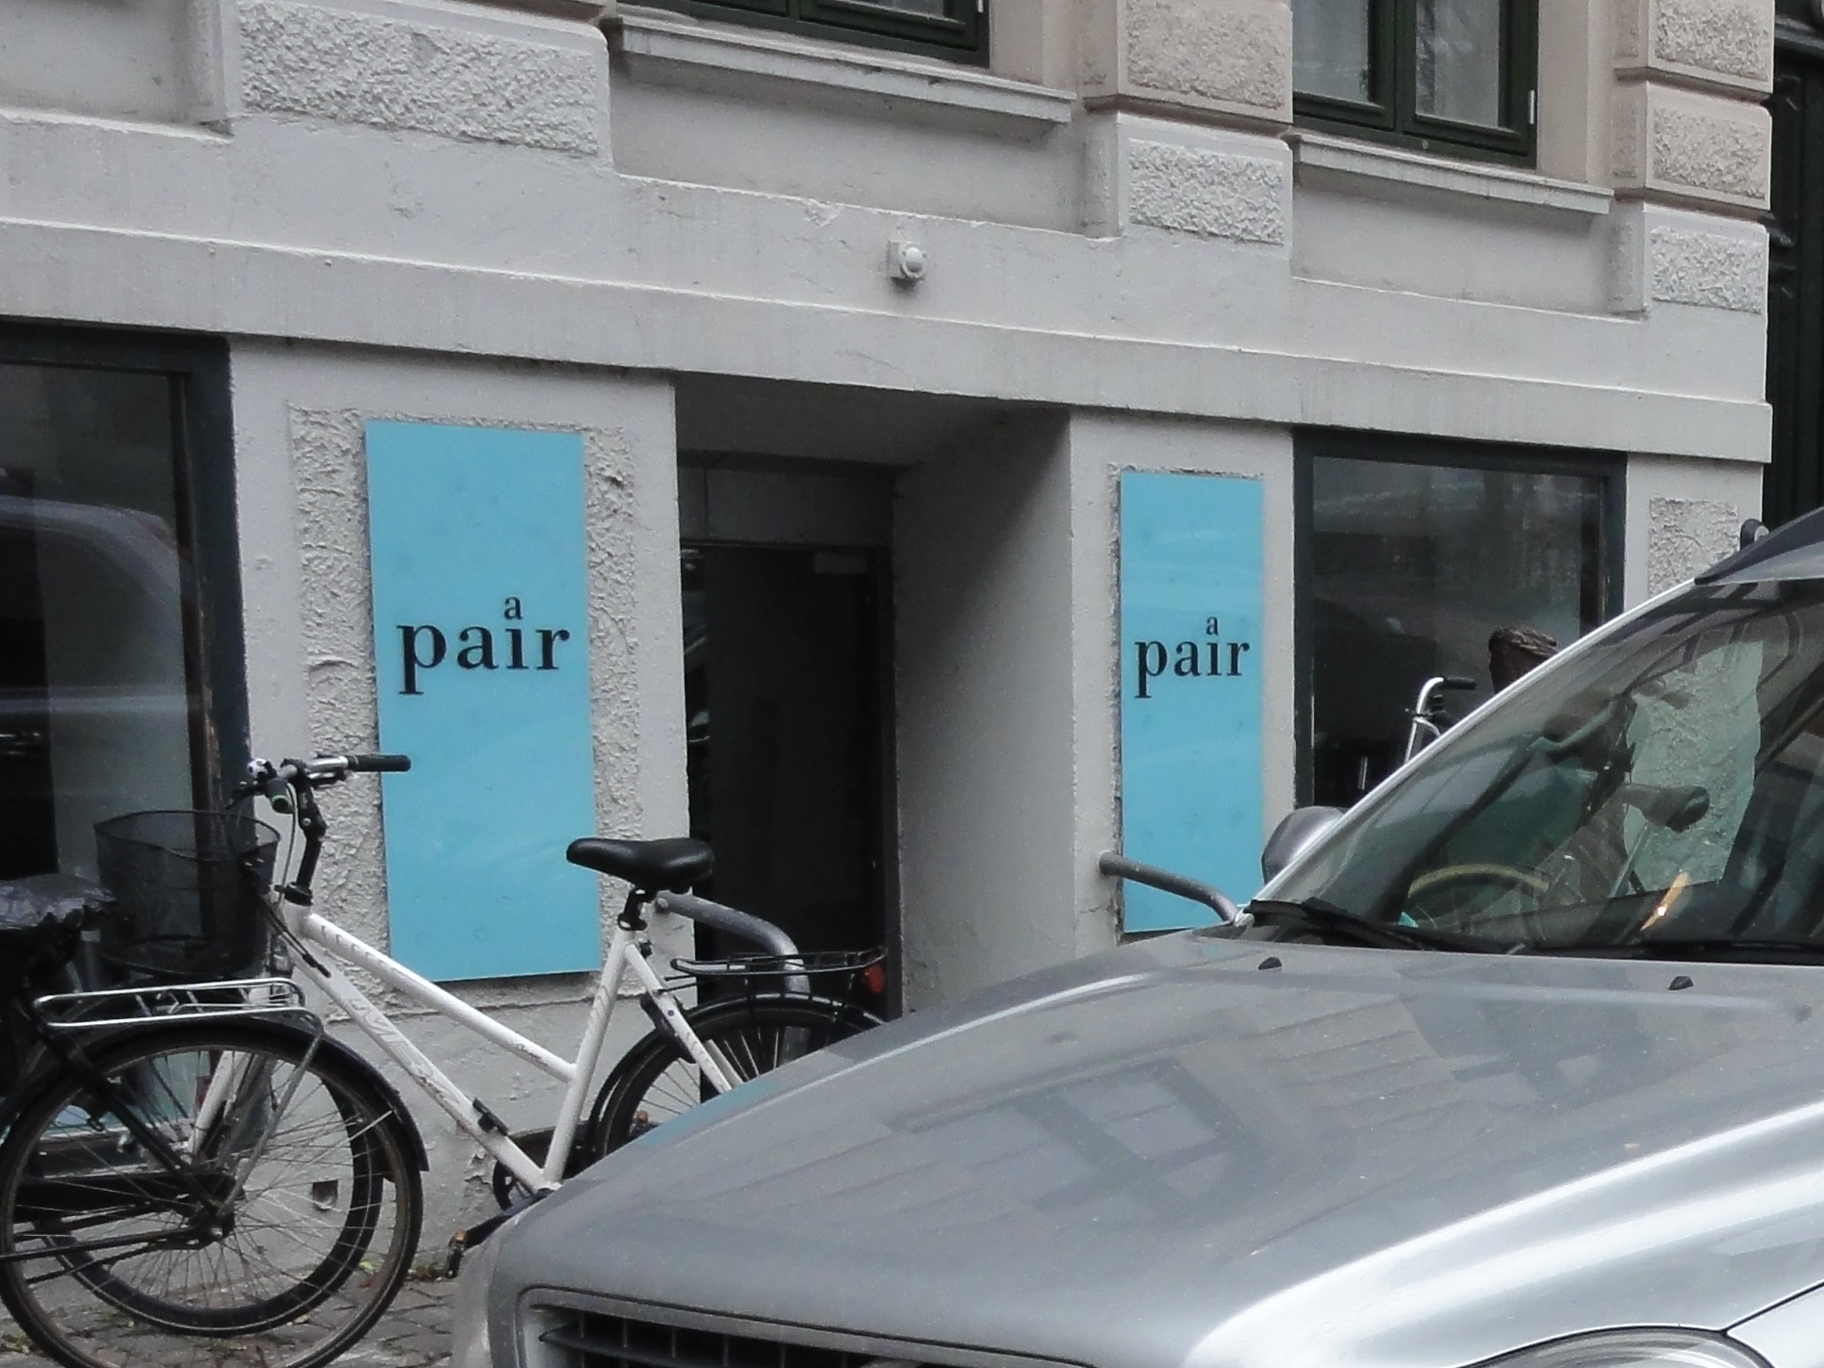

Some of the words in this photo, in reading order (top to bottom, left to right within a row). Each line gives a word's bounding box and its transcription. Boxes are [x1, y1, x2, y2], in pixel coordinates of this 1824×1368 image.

[503, 596, 523, 620] a
[1206, 616, 1219, 636] a
[396, 624, 570, 696] pair
[1133, 640, 1251, 699] pair
